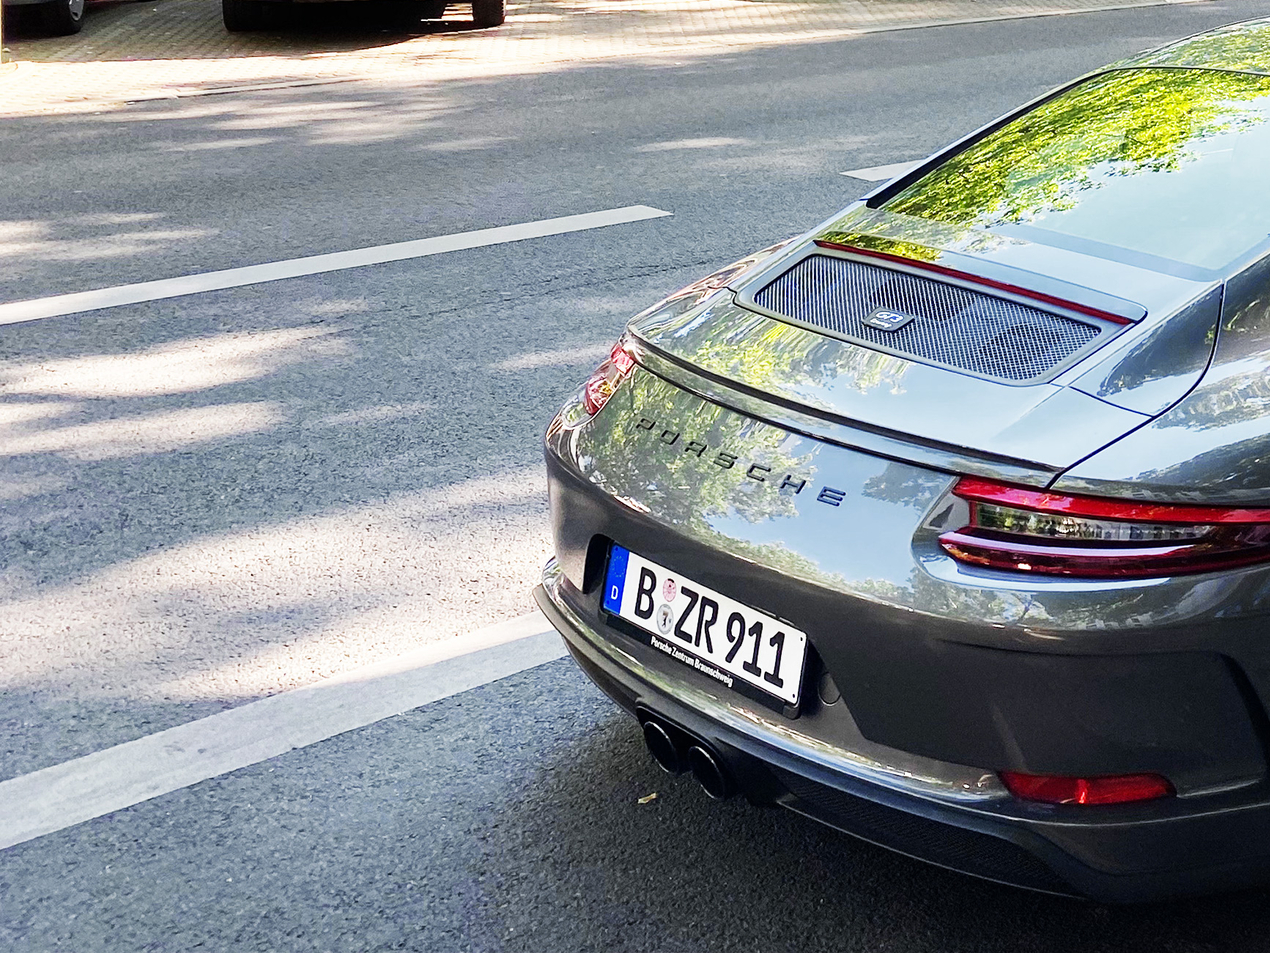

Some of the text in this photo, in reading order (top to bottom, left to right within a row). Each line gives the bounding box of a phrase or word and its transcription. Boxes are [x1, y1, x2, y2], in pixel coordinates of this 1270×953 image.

[636, 417, 846, 507] PORSCHE
[634, 566, 657, 620] B
[674, 585, 719, 654] ZR
[725, 611, 786, 689] 911
[650, 635, 734, 688] Porsche Zentrum Braunschweig
